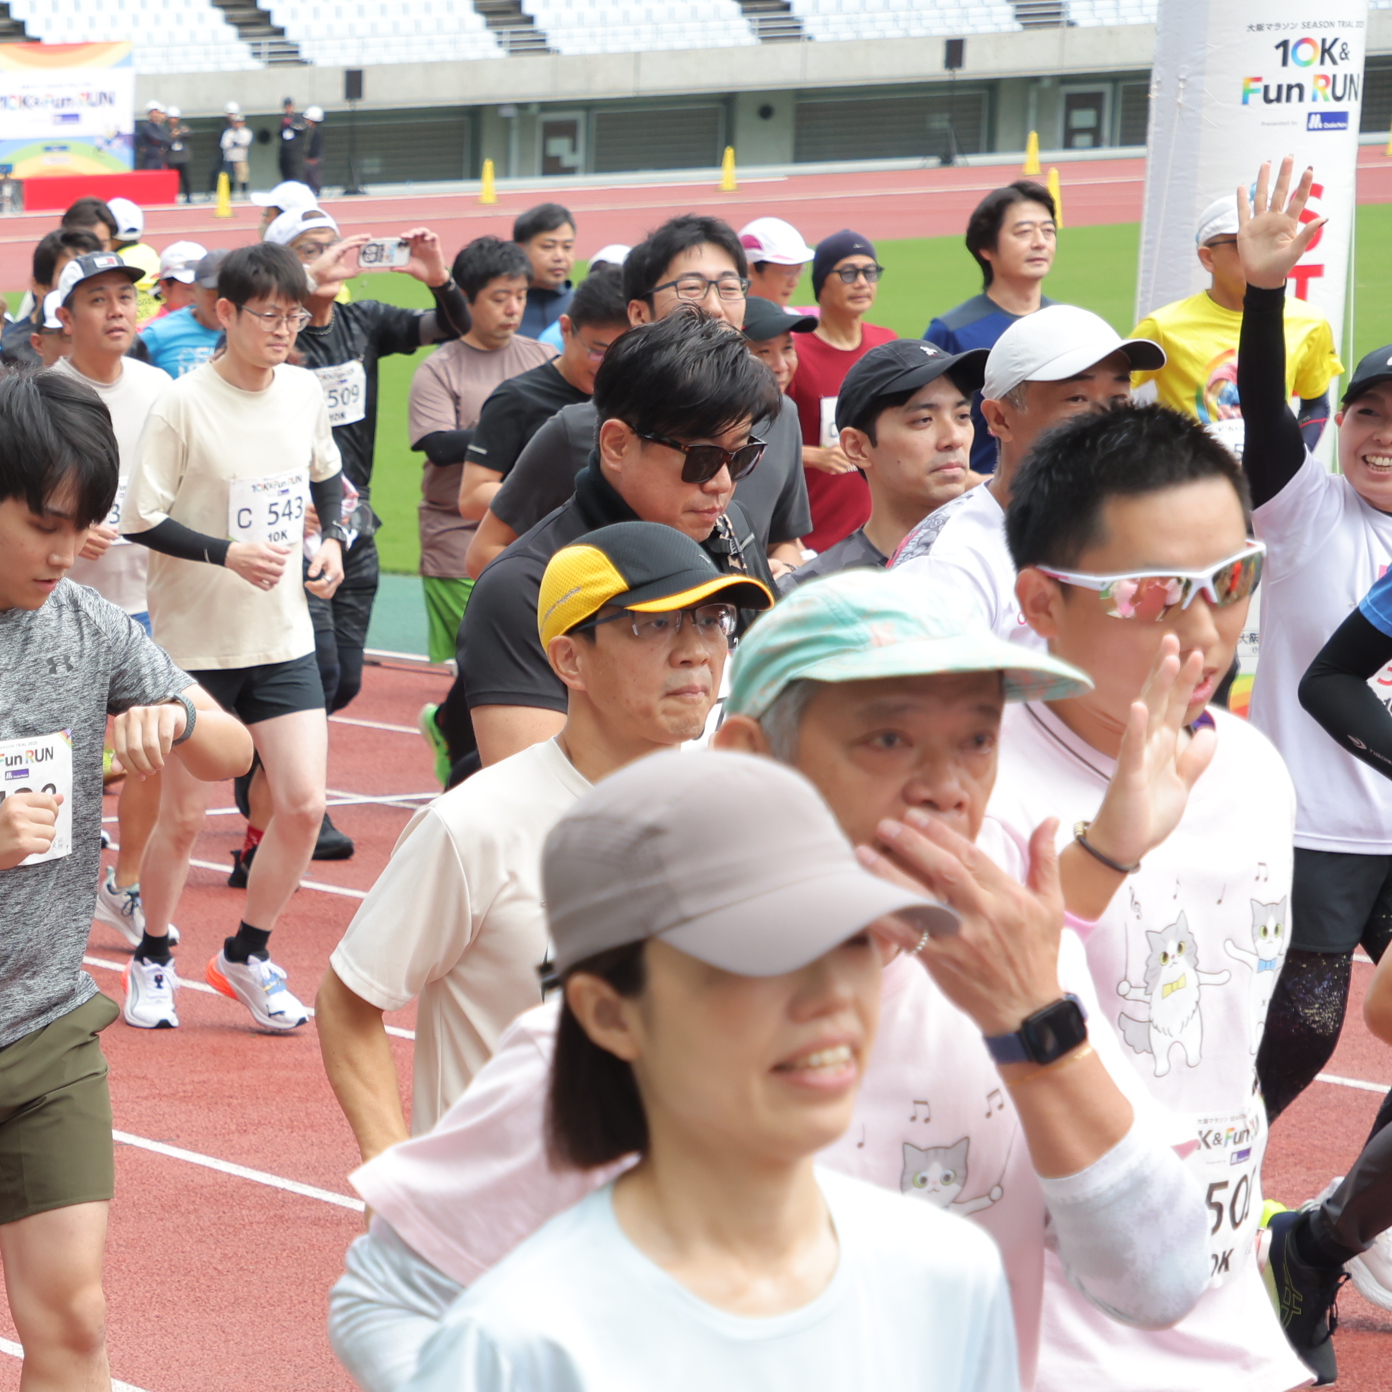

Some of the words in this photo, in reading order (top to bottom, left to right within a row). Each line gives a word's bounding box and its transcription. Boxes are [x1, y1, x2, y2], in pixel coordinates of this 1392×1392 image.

[1301, 20, 1335, 29] SEASON
[1242, 76, 1305, 105] Fun
[1312, 73, 1360, 103] RUN
[327, 384, 360, 409] 509
[237, 508, 252, 529] C
[267, 496, 304, 526] 543
[268, 530, 288, 542] 10K
[25, 746, 54, 764] RUN
